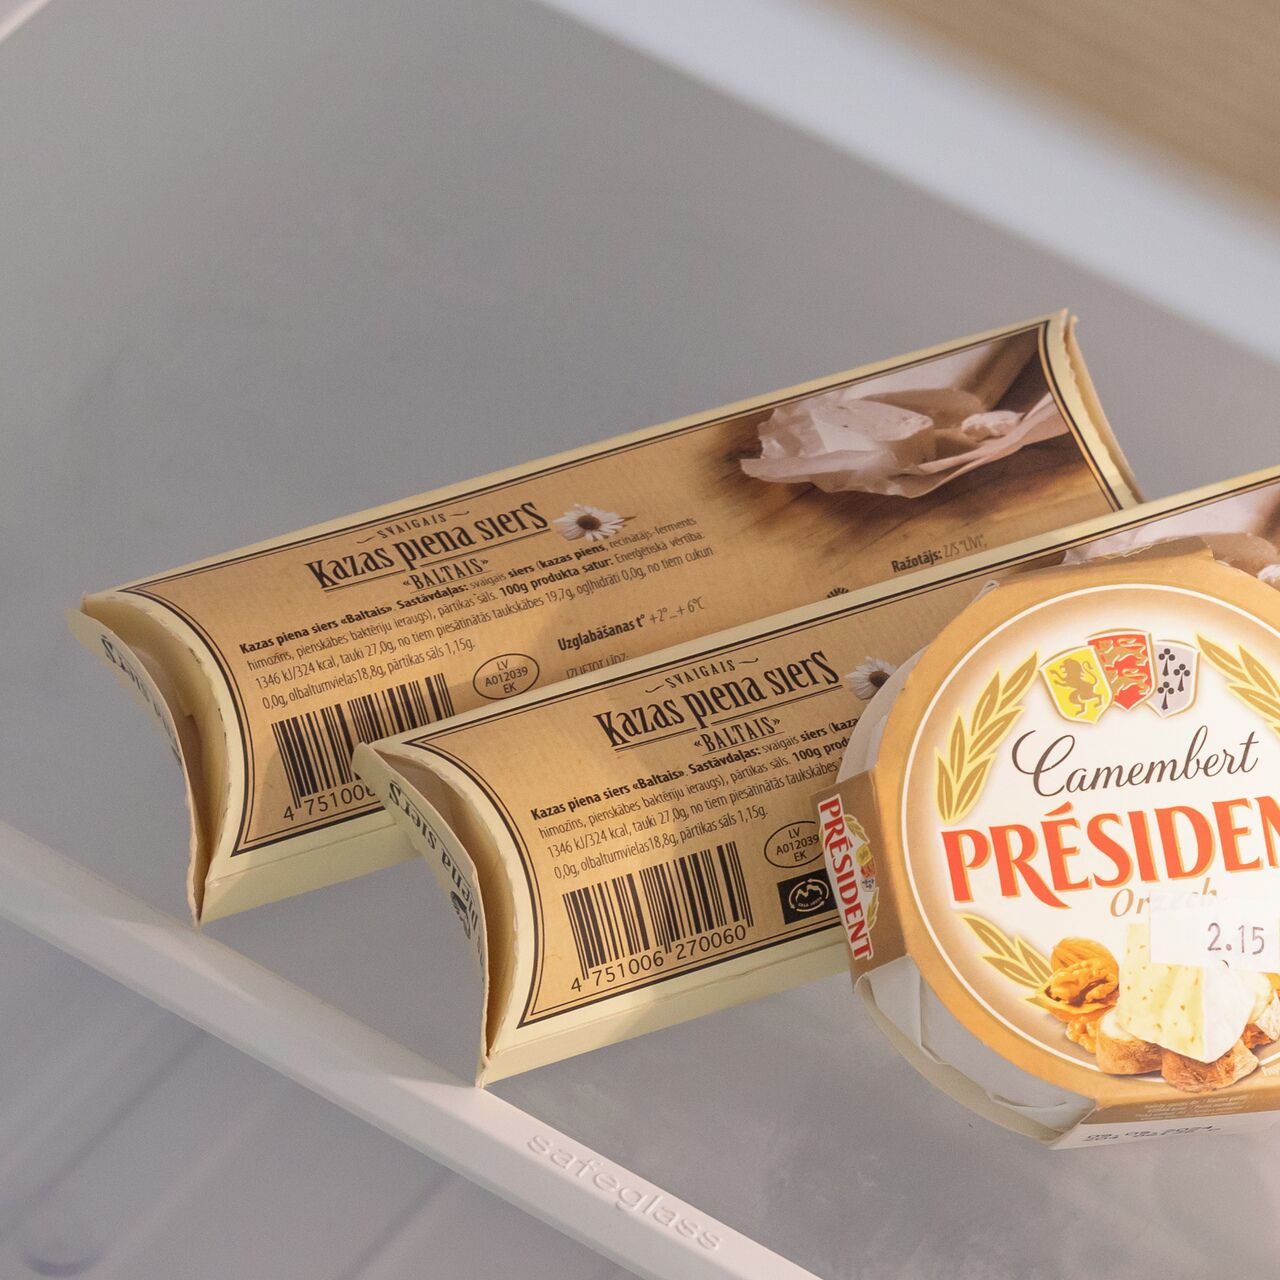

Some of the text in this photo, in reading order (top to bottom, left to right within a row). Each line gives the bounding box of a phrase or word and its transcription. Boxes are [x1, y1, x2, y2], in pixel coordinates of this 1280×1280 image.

[377, 513, 448, 539] SVAIGAIS
[305, 546, 395, 590] Kazas
[392, 526, 476, 571] piena
[402, 558, 489, 591] «BALTAIS»
[891, 550, 943, 573] Ražotājs:
[239, 637, 274, 654] Kazas
[276, 628, 309, 646] piena
[311, 619, 338, 634] siers
[396, 584, 469, 610] Sastāvdaļas:
[470, 573, 507, 590] svaigais
[507, 565, 535, 579] siers
[536, 553, 572, 571] (kazas
[574, 544, 608, 562] piens,
[297, 634, 348, 659] pienskābes
[349, 621, 393, 642] baktēriju
[437, 598, 476, 618] pārtikas
[499, 582, 529, 598] 100g
[531, 565, 580, 591] produkta
[582, 557, 614, 572] satur:
[256, 672, 281, 690] 1346
[316, 655, 339, 672] kcal,
[341, 649, 364, 665] tauki
[398, 634, 411, 647] no
[412, 629, 435, 643] tiem
[436, 612, 492, 638] piesātinātās
[492, 595, 545, 619] taukskābes
[647, 562, 661, 575] no
[661, 556, 683, 571] tiem
[557, 621, 635, 651] Uzglabāšanas
[387, 653, 425, 677] pārtikas
[426, 646, 445, 661] sāls
[485, 666, 528, 687] A012039
[496, 659, 509, 671] LV
[665, 659, 736, 688] SVAIGAIS
[503, 683, 517, 694] EK
[593, 697, 684, 748] Kazas
[680, 674, 767, 730] piena
[693, 716, 781, 752] «BALTAIS»
[530, 804, 566, 821] Kazas
[568, 793, 601, 813] piena
[603, 784, 631, 800] siers
[688, 747, 760, 775] Sastāvdaļas:
[762, 735, 799, 754] svaigais
[800, 727, 828, 742] siers
[829, 717, 861, 734] (kaza
[1011, 725, 1261, 797] Camembert
[588, 800, 641, 828] pienskābes
[641, 787, 685, 808] baktēriju
[686, 775, 729, 796] ieraugs),
[730, 763, 769, 783] pārtikas
[792, 748, 822, 763] 100g
[283, 805, 295, 823] 4
[547, 840, 573, 859] 1346
[574, 830, 607, 851] kJ/324
[608, 823, 631, 840] kcal,
[632, 815, 657, 832] tauki
[690, 803, 704, 816] no
[704, 795, 728, 810] tiem
[728, 778, 785, 806] piesātinātās
[785, 760, 838, 785] taukskābes
[679, 820, 718, 845] pārtikas
[718, 812, 737, 829] sāls
[776, 834, 820, 855] A012039
[788, 827, 801, 840] LV
[793, 850, 808, 862] EK
[820, 797, 872, 958] PRÉSIDENT
[1207, 922, 1266, 956] 2.15
[571, 924, 747, 993] 4 751006 270060
[526, 1134, 721, 1251] safeglass
